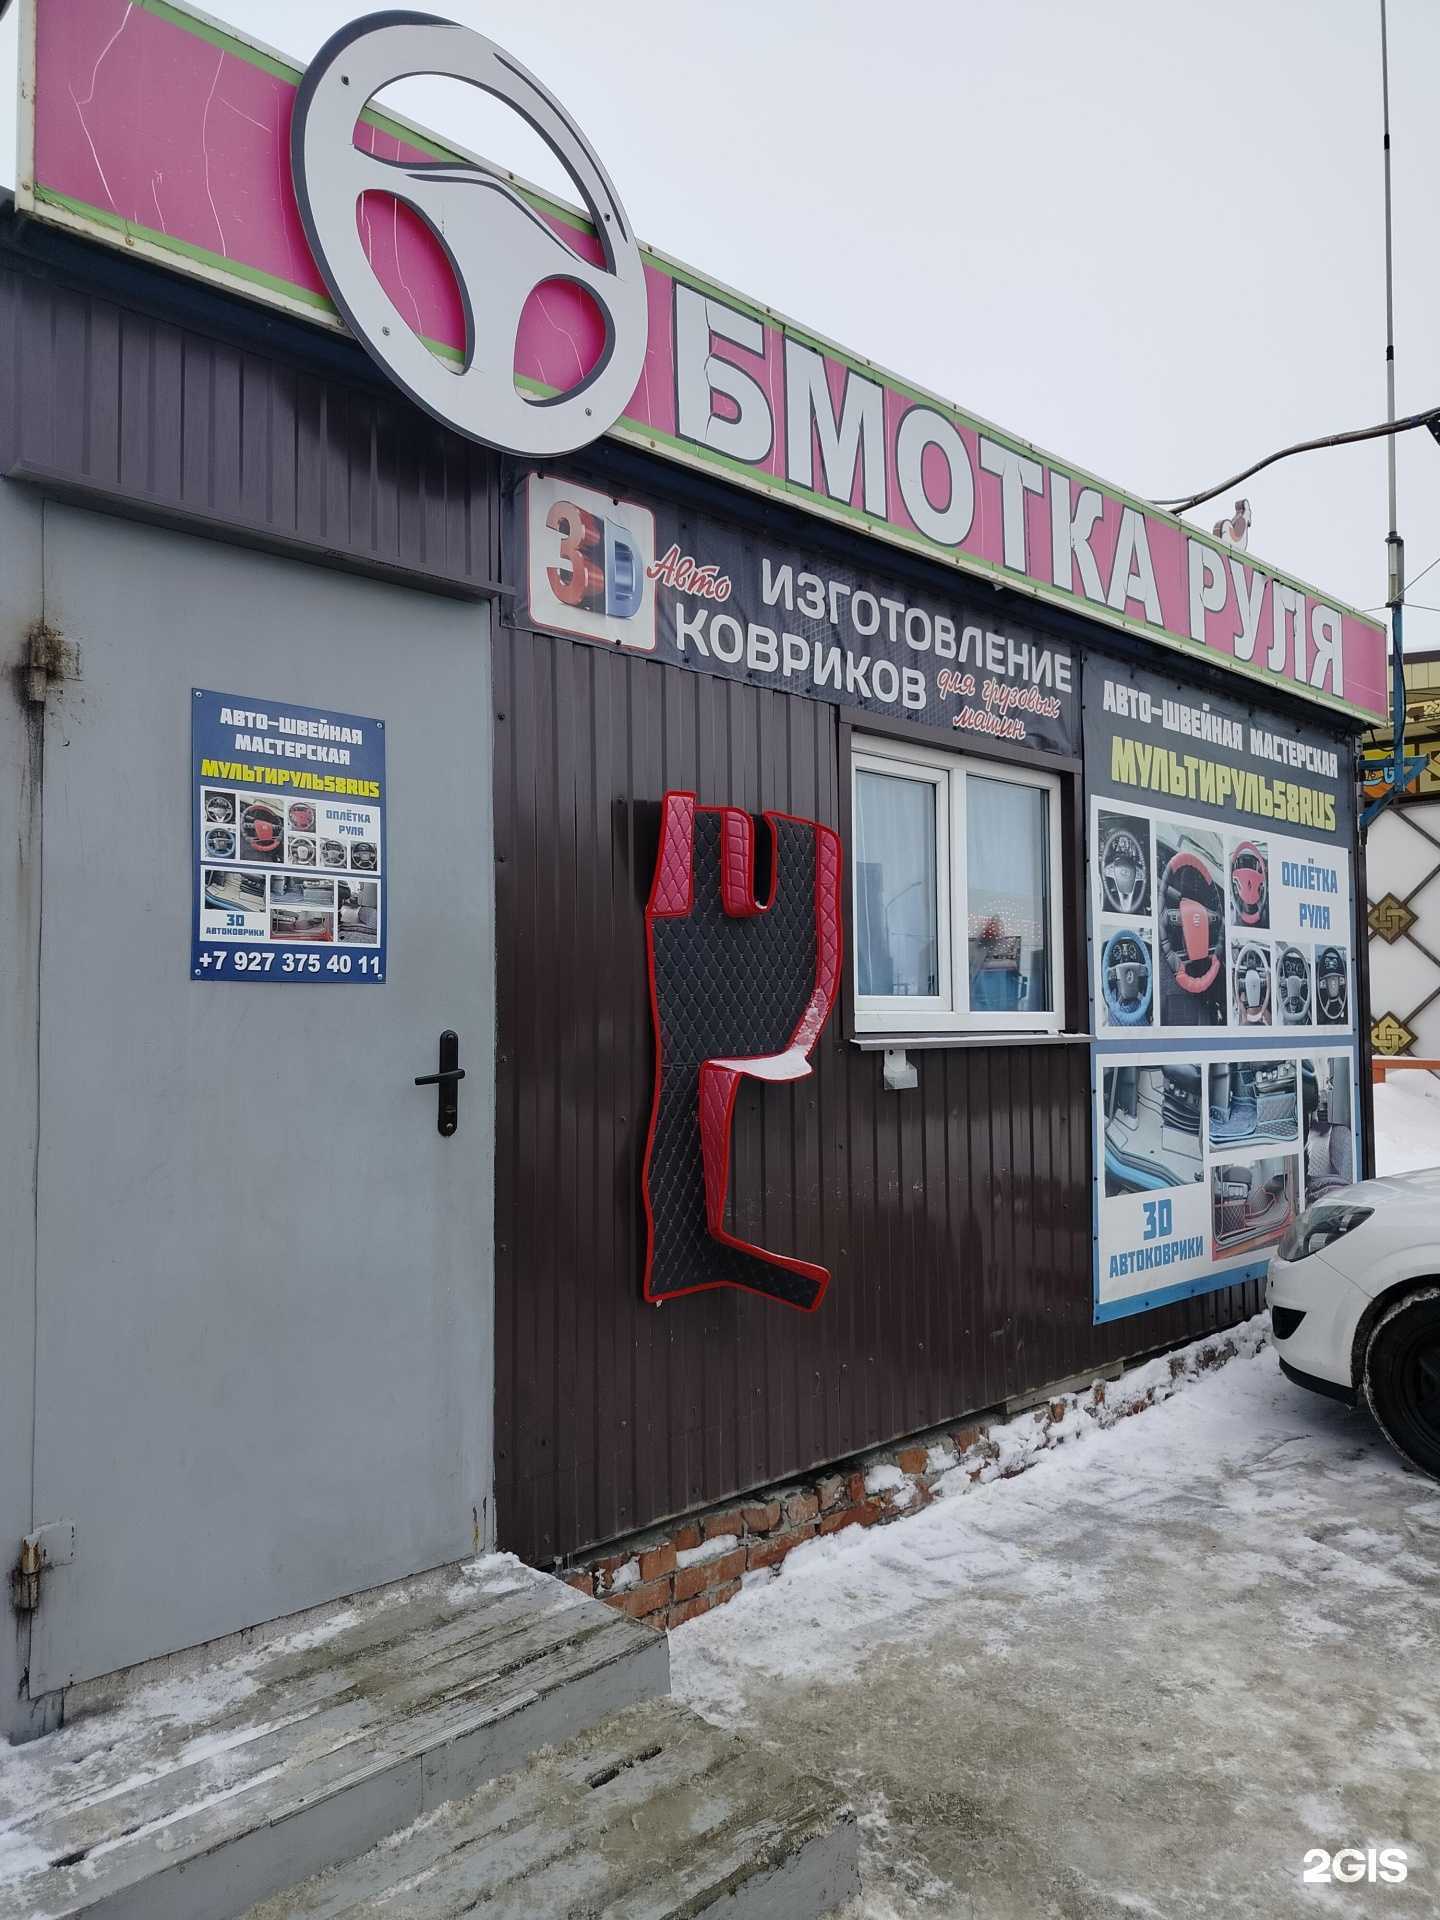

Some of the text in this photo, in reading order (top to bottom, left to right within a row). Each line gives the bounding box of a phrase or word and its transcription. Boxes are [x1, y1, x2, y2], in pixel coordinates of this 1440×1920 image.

[545, 500, 644, 620] 3D
[647, 544, 732, 603] Авто
[762, 558, 1073, 694] ИЗГОТОВЛЕНИЕ
[1187, 536, 1344, 699] РУЛЯ
[675, 602, 928, 711] КОВРИКОВ
[936, 668, 1061, 720] для грузовых
[220, 707, 363, 745] АВТО-ШВЕЙНАЯ
[952, 705, 1026, 740] машин
[1103, 680, 1339, 778] АВТО-ШВЕЙНАЯ МАСТЕРСКАЯ
[234, 733, 351, 766] МАСТЕРСКАЯ
[325, 809, 372, 825] ОПЛЁТКА
[338, 824, 365, 837] РУЛЯ
[1281, 857, 1339, 894] ОПЛЁТКА
[206, 926, 265, 938] АВТОКОВРИКИ
[226, 914, 245, 927] 3D
[1299, 902, 1331, 930] РУЛЯ
[199, 951, 380, 975] +7 927 375 40 11
[1143, 1198, 1173, 1241] 3D
[1109, 1235, 1204, 1279] АВТОКОВРИКИ
